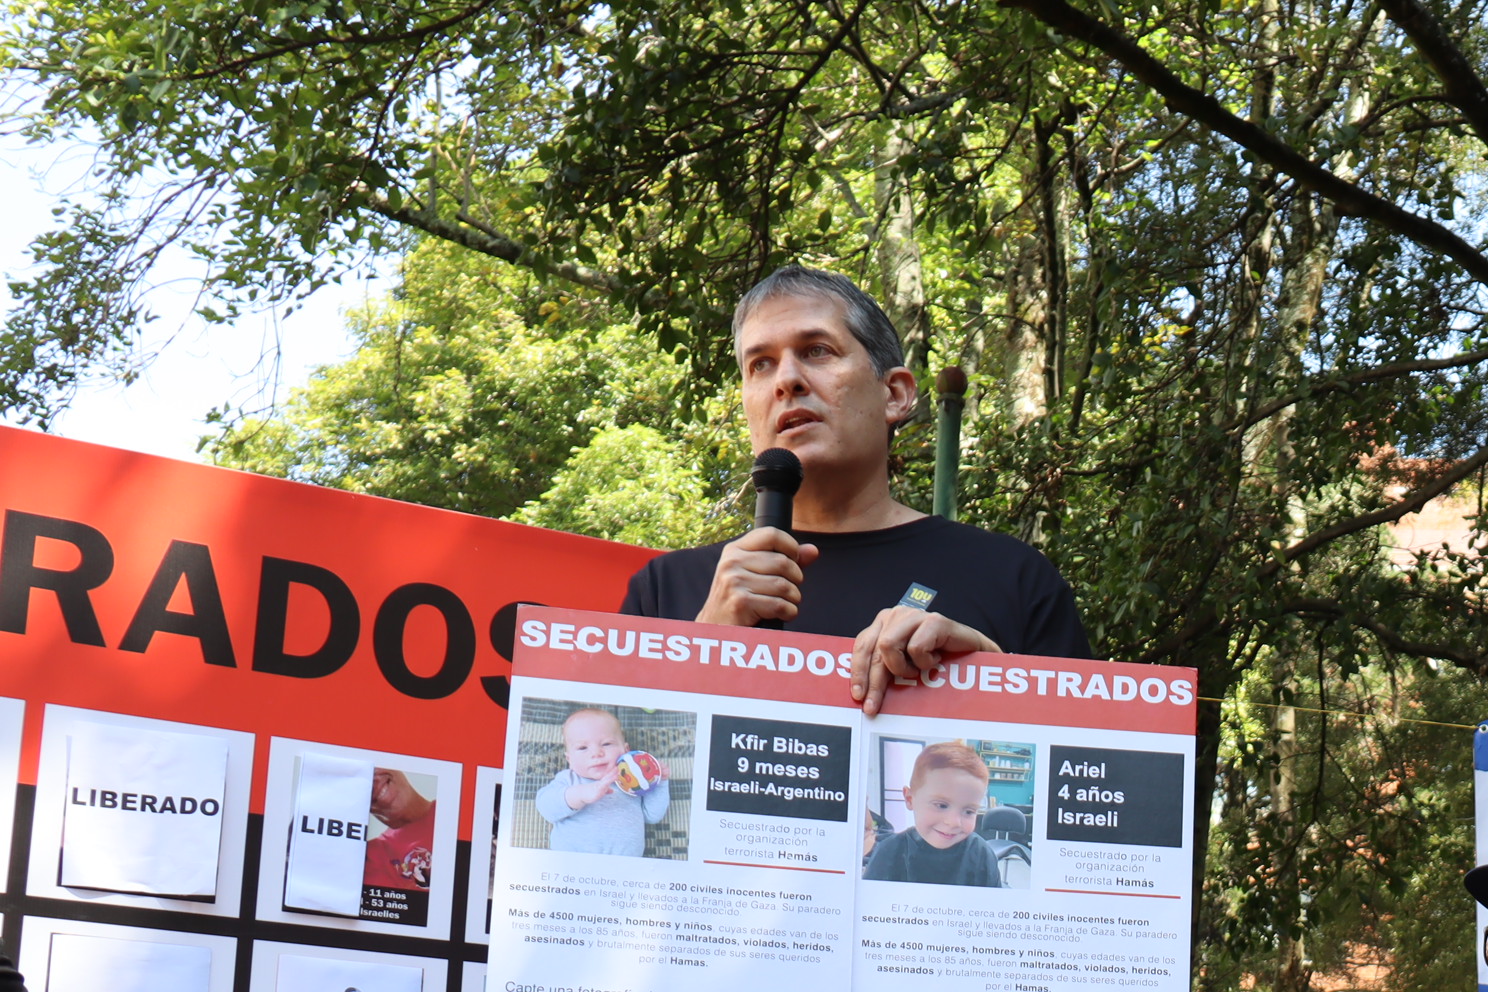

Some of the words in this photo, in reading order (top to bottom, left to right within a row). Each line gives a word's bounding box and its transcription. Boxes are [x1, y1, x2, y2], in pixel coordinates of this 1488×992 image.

[731, 733, 767, 751] Kfir
[773, 737, 828, 757] Bibas
[738, 757, 749, 773] 9
[755, 762, 819, 779] meses
[1059, 760, 1105, 778] Ariel
[710, 777, 845, 801] Israeli-Argentino
[1058, 784, 1070, 800] 4
[1076, 786, 1124, 803] años
[71, 786, 220, 817] LIBERADO
[1058, 808, 1118, 827] Israeli
[720, 819, 790, 833] Secuestrado
[794, 827, 812, 836] por
[816, 827, 825, 837] la
[736, 834, 808, 846] organización
[725, 847, 774, 859] terrorista
[778, 850, 818, 862] Hamás
[1060, 847, 1127, 860] Secuestrado
[1131, 854, 1148, 863] por
[1152, 853, 1161, 863] la
[1075, 862, 1144, 872] organización
[510, 884, 581, 896] secuestrados
[1065, 875, 1112, 885] terrorista
[1116, 877, 1154, 888] Hamás
[369, 889, 382, 897] 11
[384, 891, 406, 900] años
[669, 883, 687, 891] 200
[690, 885, 723, 894] civiles
[727, 887, 776, 898] inocentes
[779, 891, 812, 901] fueron
[371, 899, 383, 907] 53
[386, 901, 408, 910] años
[509, 908, 529, 917] Más
[533, 910, 546, 919] de
[549, 912, 574, 921] 4500
[577, 915, 621, 925] mujeres,
[626, 917, 671, 928] hombres
[862, 916, 929, 925] secuestrados
[525, 936, 585, 946] asesinados
[676, 934, 739, 946] maltratados,
[743, 939, 789, 950] violados,
[793, 941, 833, 952] heridos,
[877, 965, 934, 975] asesinados
